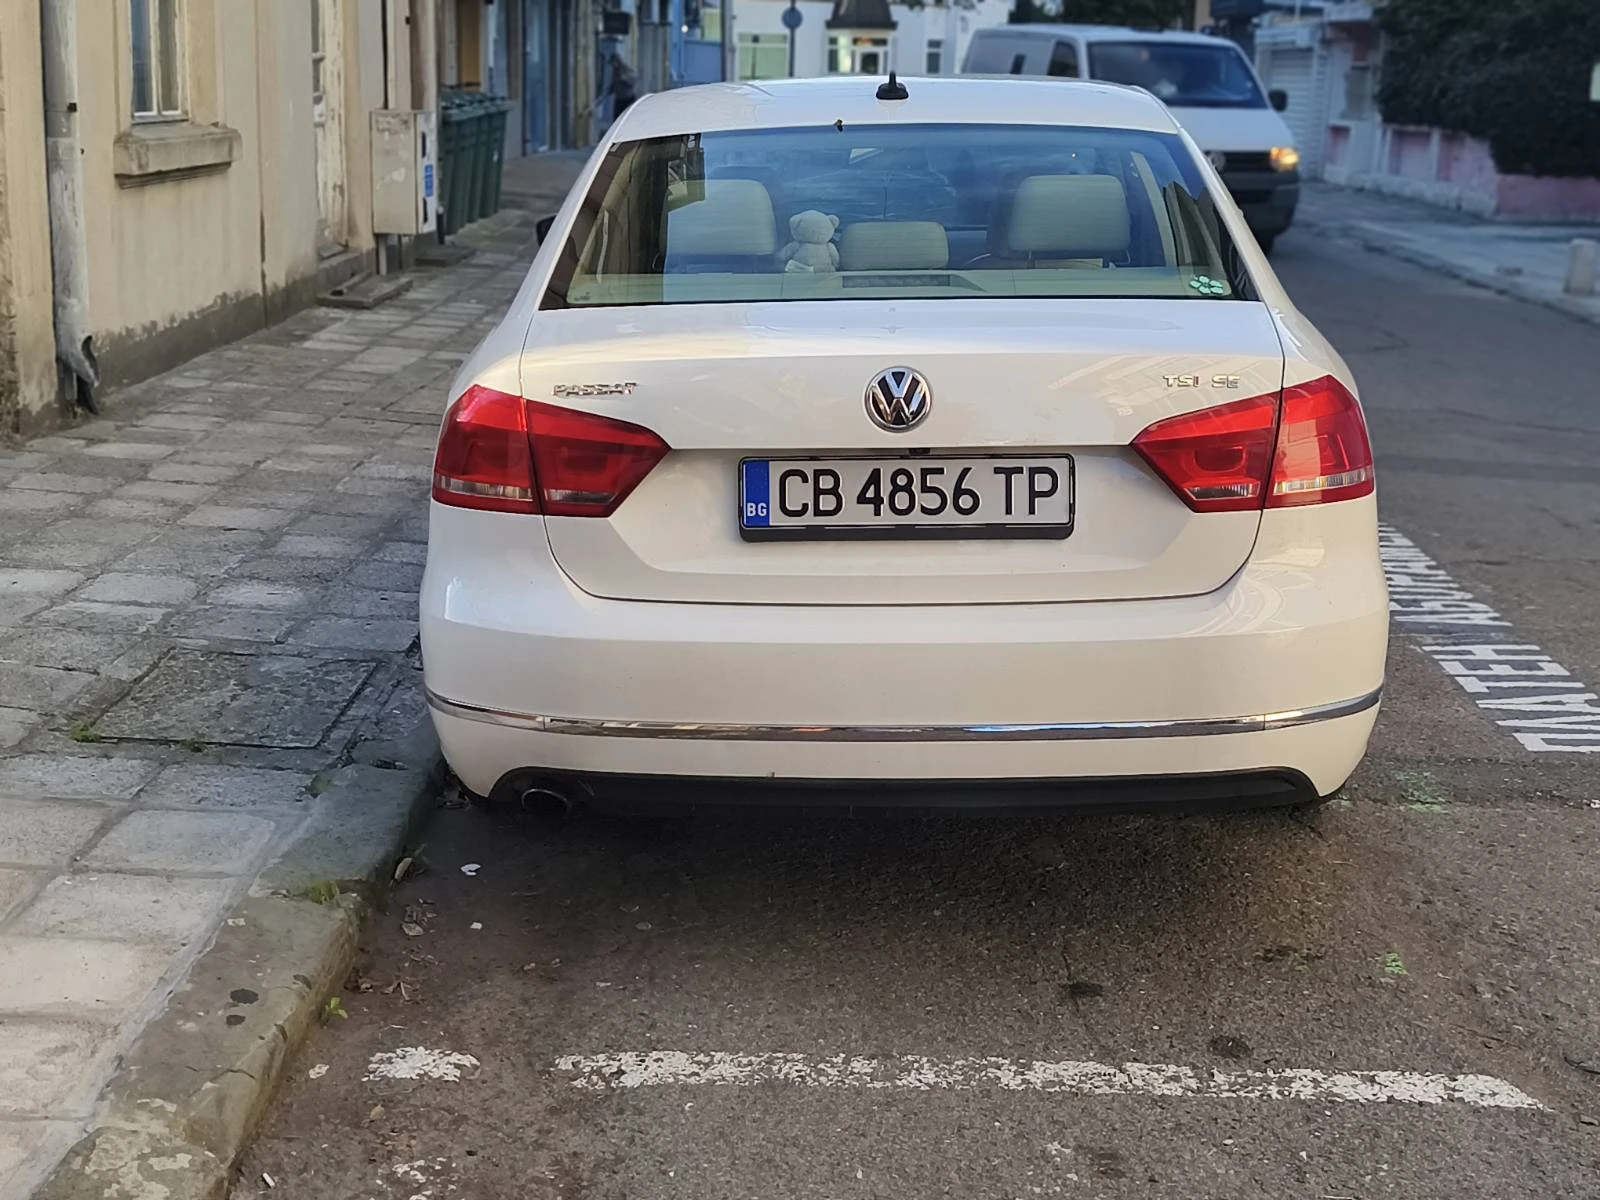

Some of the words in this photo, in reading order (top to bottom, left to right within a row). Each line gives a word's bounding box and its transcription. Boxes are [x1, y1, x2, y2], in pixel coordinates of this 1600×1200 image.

[551, 382, 638, 397] PASSAT
[1163, 374, 1200, 388] TSI
[1211, 374, 1241, 389] SE
[866, 367, 931, 431] VW
[779, 468, 844, 518] CB
[856, 467, 981, 517] 4856
[993, 466, 1059, 516] TP
[746, 502, 768, 517] BG
[1421, 644, 1600, 752] ПЛАТЕН
